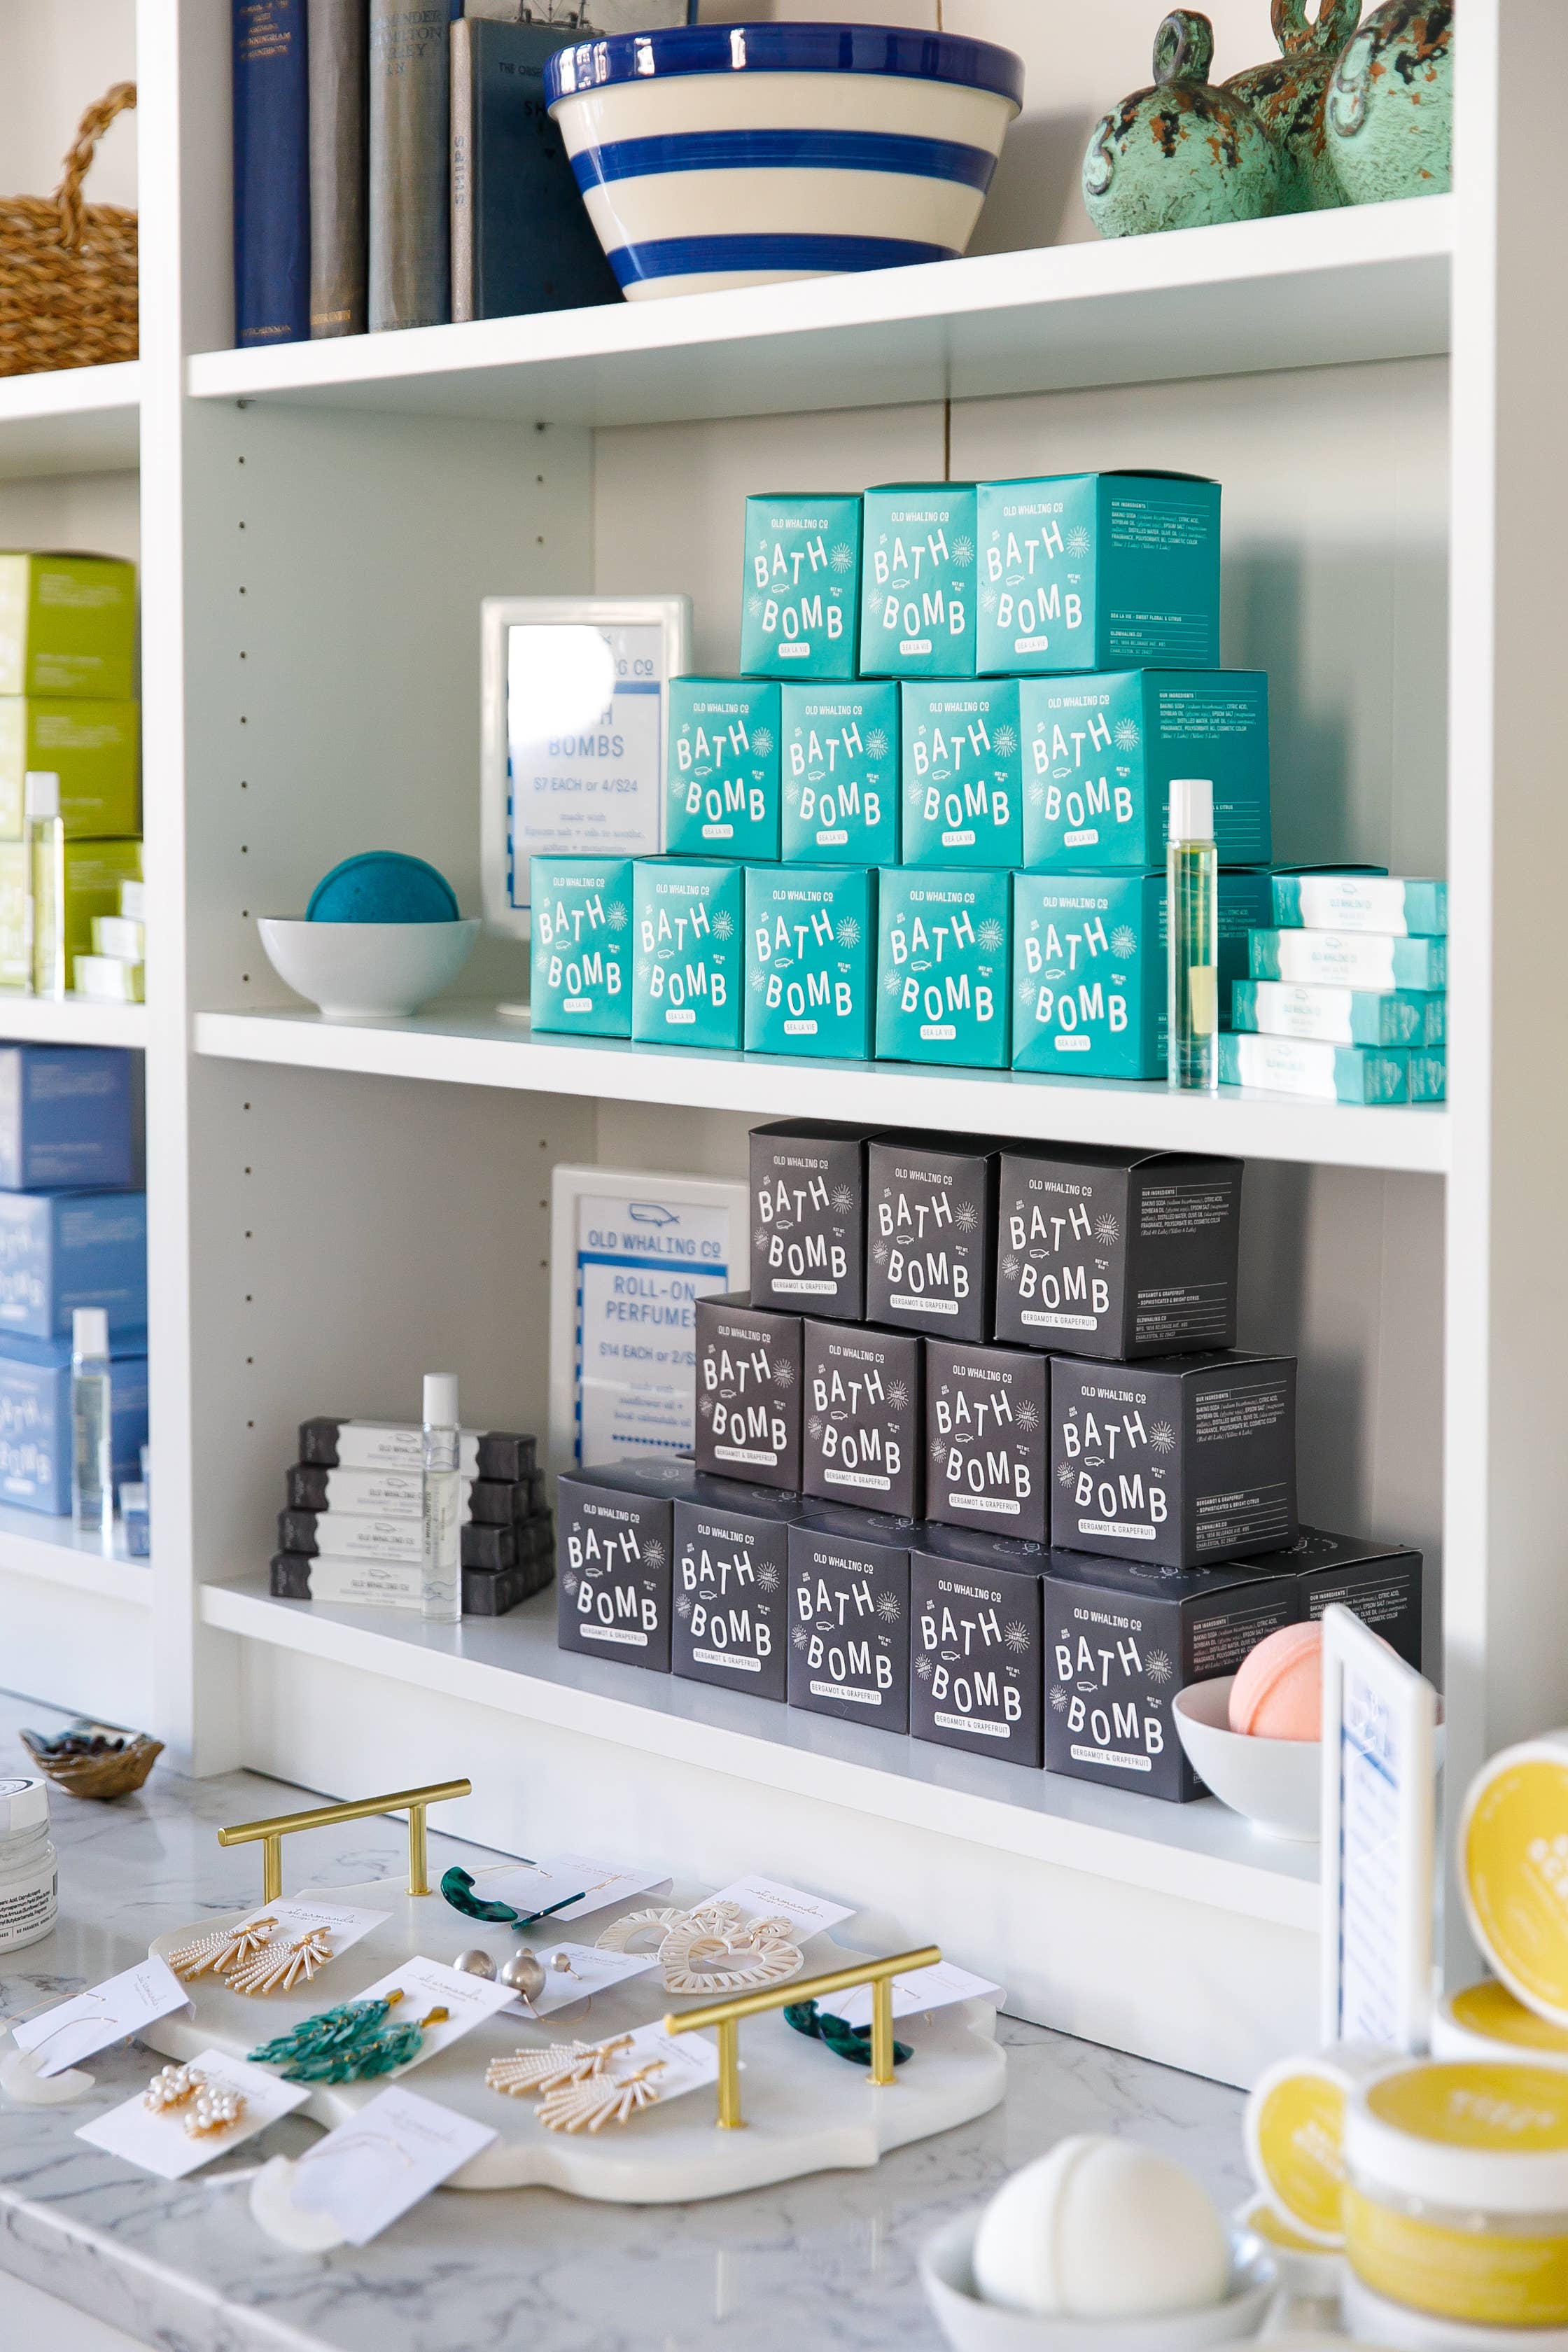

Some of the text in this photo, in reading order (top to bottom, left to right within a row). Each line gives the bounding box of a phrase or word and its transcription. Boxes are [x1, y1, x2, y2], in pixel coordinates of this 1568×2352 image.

[454, 136, 465, 204] SHIPS
[771, 519, 784, 528] OLD
[785, 519, 817, 528] WHALING
[891, 512, 904, 522] OLD
[906, 512, 938, 521] WHALING
[1004, 506, 1016, 516] OLD
[1018, 505, 1052, 514] WHALING
[755, 536, 828, 588] BATH
[874, 528, 949, 584] BATH
[986, 520, 1064, 582] BATH
[762, 595, 843, 639] BOMB
[883, 590, 965, 636] BOMB
[997, 583, 1082, 634] BOMB
[806, 706, 818, 715] OLD
[820, 706, 851, 715] WHALING
[930, 703, 942, 712] OLD
[944, 702, 977, 711] WHALING
[1049, 698, 1061, 708] OLD
[1063, 696, 1098, 707] WHALING
[548, 734, 624, 757] BOMBS
[677, 720, 750, 771] BATH
[790, 722, 863, 775] BATH
[913, 719, 990, 775] BATH
[1032, 713, 1112, 774] BATH
[534, 778, 638, 792] $7 EACH or 4/$24
[686, 778, 765, 821] BOMB
[799, 782, 881, 826] BOMB
[923, 780, 1009, 827] BOMB
[1044, 777, 1133, 827] BOMB
[657, 884, 668, 893] OLD
[669, 885, 699, 895] WHALING
[773, 890, 785, 900] OLD
[788, 890, 822, 901] WHALING
[910, 890, 924, 901] OLD
[926, 891, 962, 902] WHALING
[1044, 897, 1057, 906] OLD
[1059, 897, 1096, 908] WHALING
[539, 894, 606, 944] BATH
[641, 902, 710, 952] BATH
[755, 909, 834, 962] BATH
[890, 910, 975, 964] BATH
[1025, 916, 1109, 973] BATH
[548, 952, 621, 994] BOMB
[650, 962, 727, 1006] BOMB
[765, 970, 853, 1016] BOMB
[901, 974, 994, 1021] BOMB
[1035, 983, 1128, 1032] BOMB
[774, 1156, 785, 1165] OLD
[788, 1156, 818, 1168] WHALING
[895, 1168, 908, 1178] OLD
[909, 1170, 941, 1183] WHALING
[759, 1175, 830, 1222] BATH
[1029, 1180, 1043, 1190] OLD
[1044, 1182, 1080, 1195] WHALING
[878, 1191, 953, 1238] BATH
[1009, 1203, 1092, 1252] BATH
[588, 1229, 617, 1248] OLD
[623, 1234, 696, 1255] WHALING
[769, 1234, 847, 1278] BOMB
[613, 1276, 696, 1301] ROLL-ON
[888, 1249, 969, 1298] BOMB
[1018, 1264, 1109, 1313] BOMB
[1023, 1314, 1052, 1323] BERGAMOT
[1060, 1317, 1095, 1326] GRAPEFRUIT
[599, 1342, 670, 1362] $14 EACH or
[704, 1348, 771, 1392] BATH
[830, 1345, 841, 1354] OLD
[843, 1348, 874, 1361] WHALING
[953, 1365, 966, 1376] OLD
[967, 1368, 1000, 1381] WHALING
[813, 1369, 885, 1414] BATH
[936, 1390, 1013, 1436] BATH
[1082, 1386, 1096, 1397] OLD
[1098, 1388, 1133, 1401] WHALING
[712, 1402, 787, 1450] BOMB
[1063, 1410, 1147, 1459] BATH
[822, 1424, 900, 1474] BOMB
[946, 1447, 1030, 1497] BOMB
[1075, 1471, 1167, 1522] BOMB
[568, 1528, 640, 1572] BATH
[698, 1525, 710, 1535] OLD
[712, 1527, 743, 1541] WHALING
[1080, 1522, 1110, 1532] BERGAMOT
[1118, 1527, 1154, 1536] GRAPEFRUIT
[682, 1549, 755, 1595] BATH
[814, 1553, 827, 1564] OLD
[829, 1556, 862, 1571] WHALING
[577, 1581, 657, 1630] BOMB
[797, 1579, 874, 1625] BATH
[939, 1580, 952, 1590] OLD
[954, 1583, 989, 1598] WHALING
[1320, 1590, 1345, 1599] INGREDIENTS
[690, 1603, 771, 1656] BOMB
[921, 1607, 1002, 1655] BATH
[1074, 1608, 1088, 1620] OLD
[1091, 1612, 1129, 1628] WHALING
[1368, 1614, 1385, 1623] COSMETIC
[808, 1634, 892, 1688] BOMB
[1056, 1636, 1142, 1686] BATH
[812, 1684, 839, 1694] BERGAMOT
[847, 1690, 880, 1702] GRAPEFRUIT
[932, 1664, 1021, 1721] BOMB
[937, 1715, 965, 1726] BERGAMOT
[973, 1721, 1007, 1734] GRAPEFRUIT
[1067, 1695, 1163, 1754] BOMB
